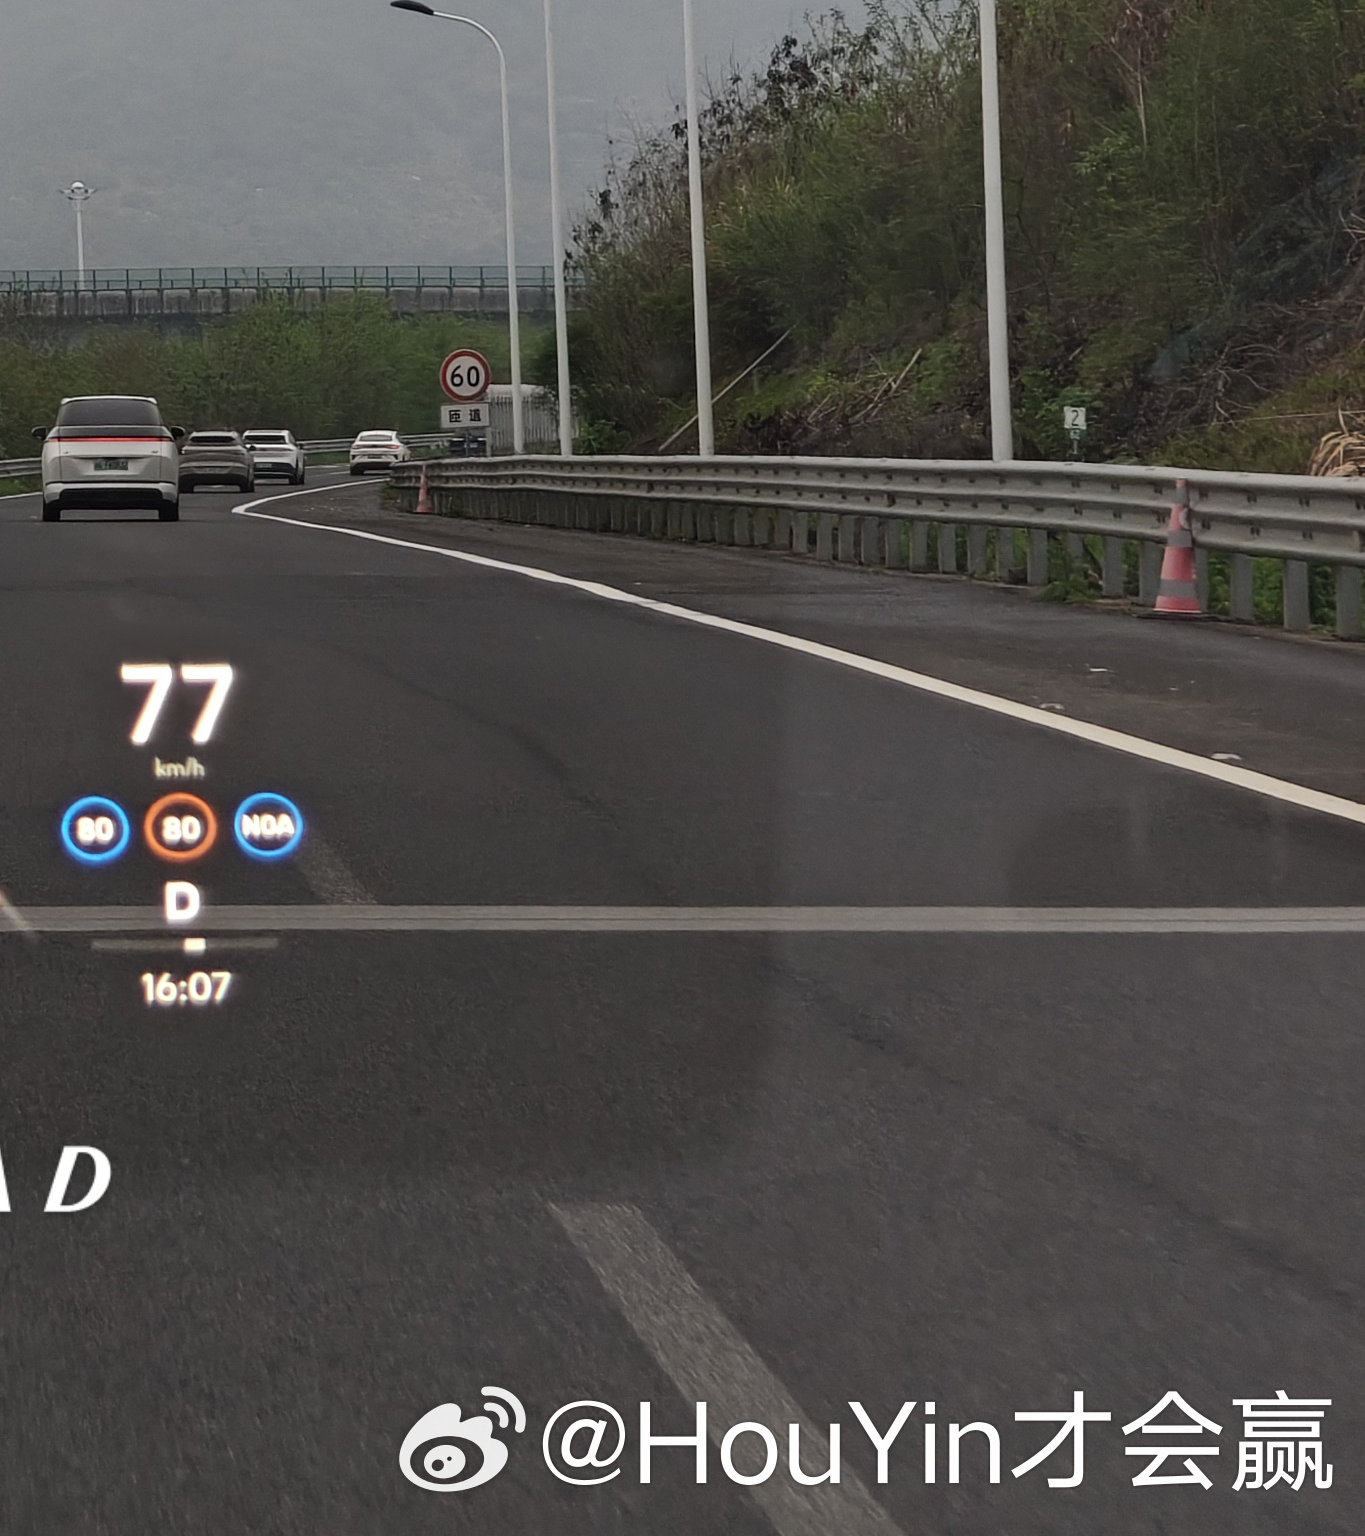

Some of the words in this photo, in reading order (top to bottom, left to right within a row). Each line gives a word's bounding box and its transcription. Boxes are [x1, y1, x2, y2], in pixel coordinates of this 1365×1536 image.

[450, 364, 480, 388] 60
[448, 408, 482, 423] 匝道
[121, 663, 234, 745] 77
[154, 757, 205, 779] km/h
[76, 816, 115, 843] 80
[162, 815, 202, 842] 80
[241, 813, 296, 838] NOA
[164, 881, 201, 924] D
[141, 972, 233, 1005] 16:07
